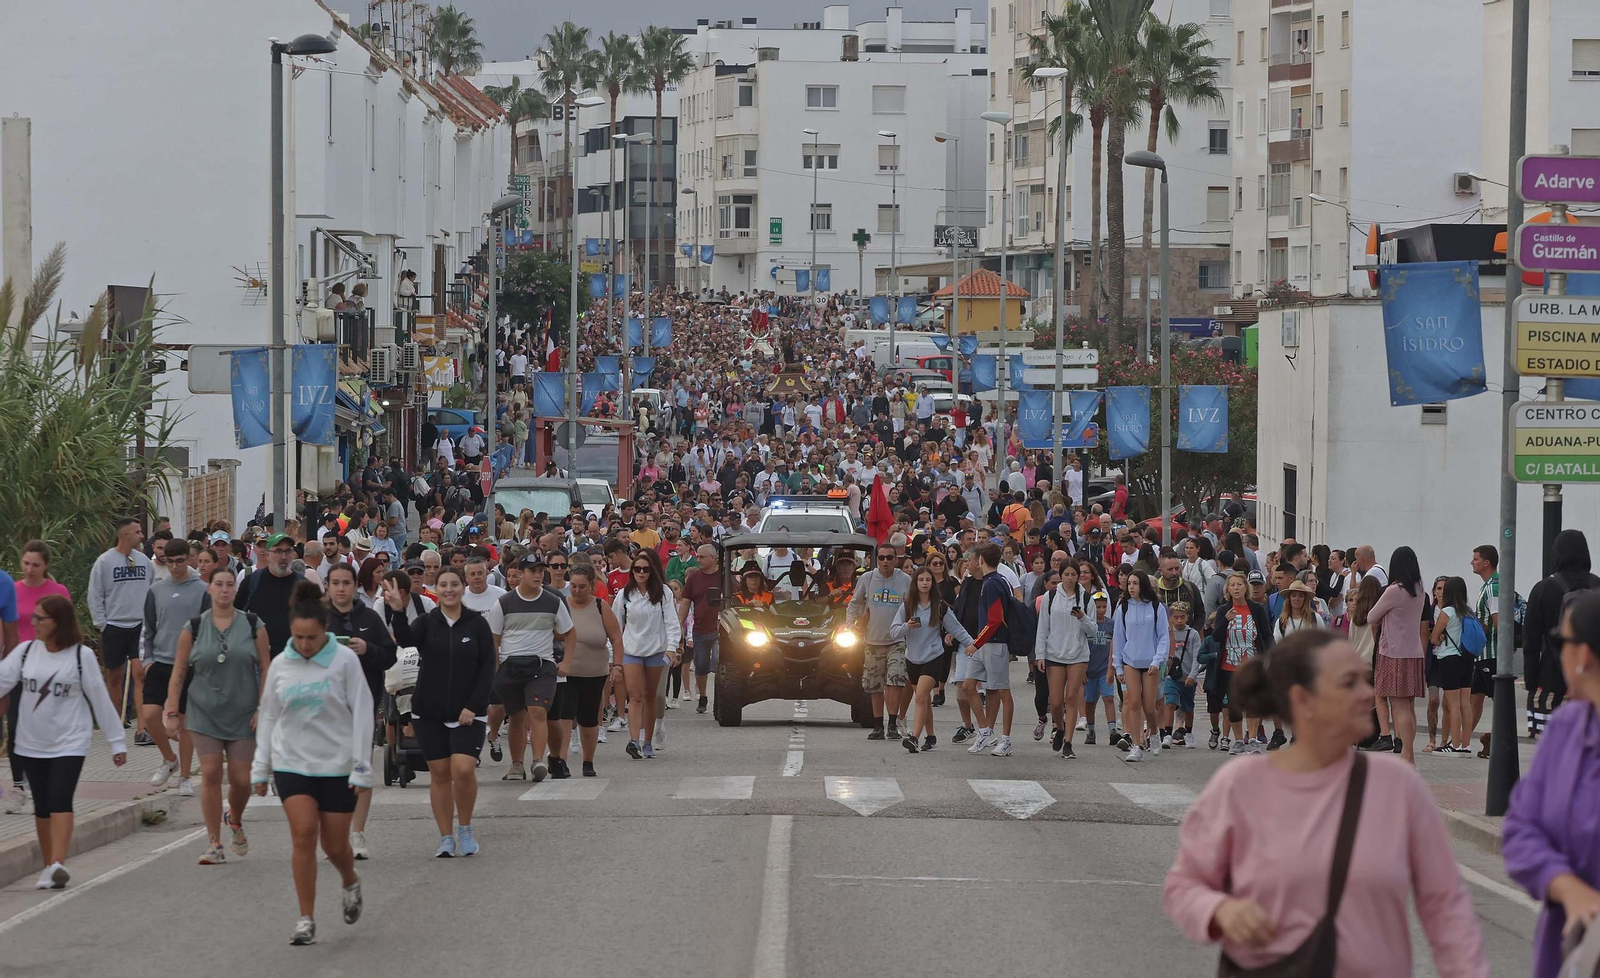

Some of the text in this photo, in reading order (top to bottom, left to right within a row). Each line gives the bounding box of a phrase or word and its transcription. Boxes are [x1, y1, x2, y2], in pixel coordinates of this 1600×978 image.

[1534, 173, 1595, 189] Adarve
[1533, 233, 1576, 243] Castillo de
[1532, 243, 1597, 260] Guzmán
[1529, 302, 1564, 315] URB.
[1569, 304, 1588, 316] LA
[1415, 315, 1448, 330] SAN
[1528, 330, 1587, 343] PISCINA
[1527, 357, 1590, 371] ESTADIO
[298, 385, 332, 406] LVZ
[1187, 407, 1220, 423] LVZ
[1525, 408, 1587, 420] CENTRO
[482, 471, 491, 481] STOP
[1525, 463, 1600, 475] C/ BATALL
[113, 565, 146, 579] GIANTS
